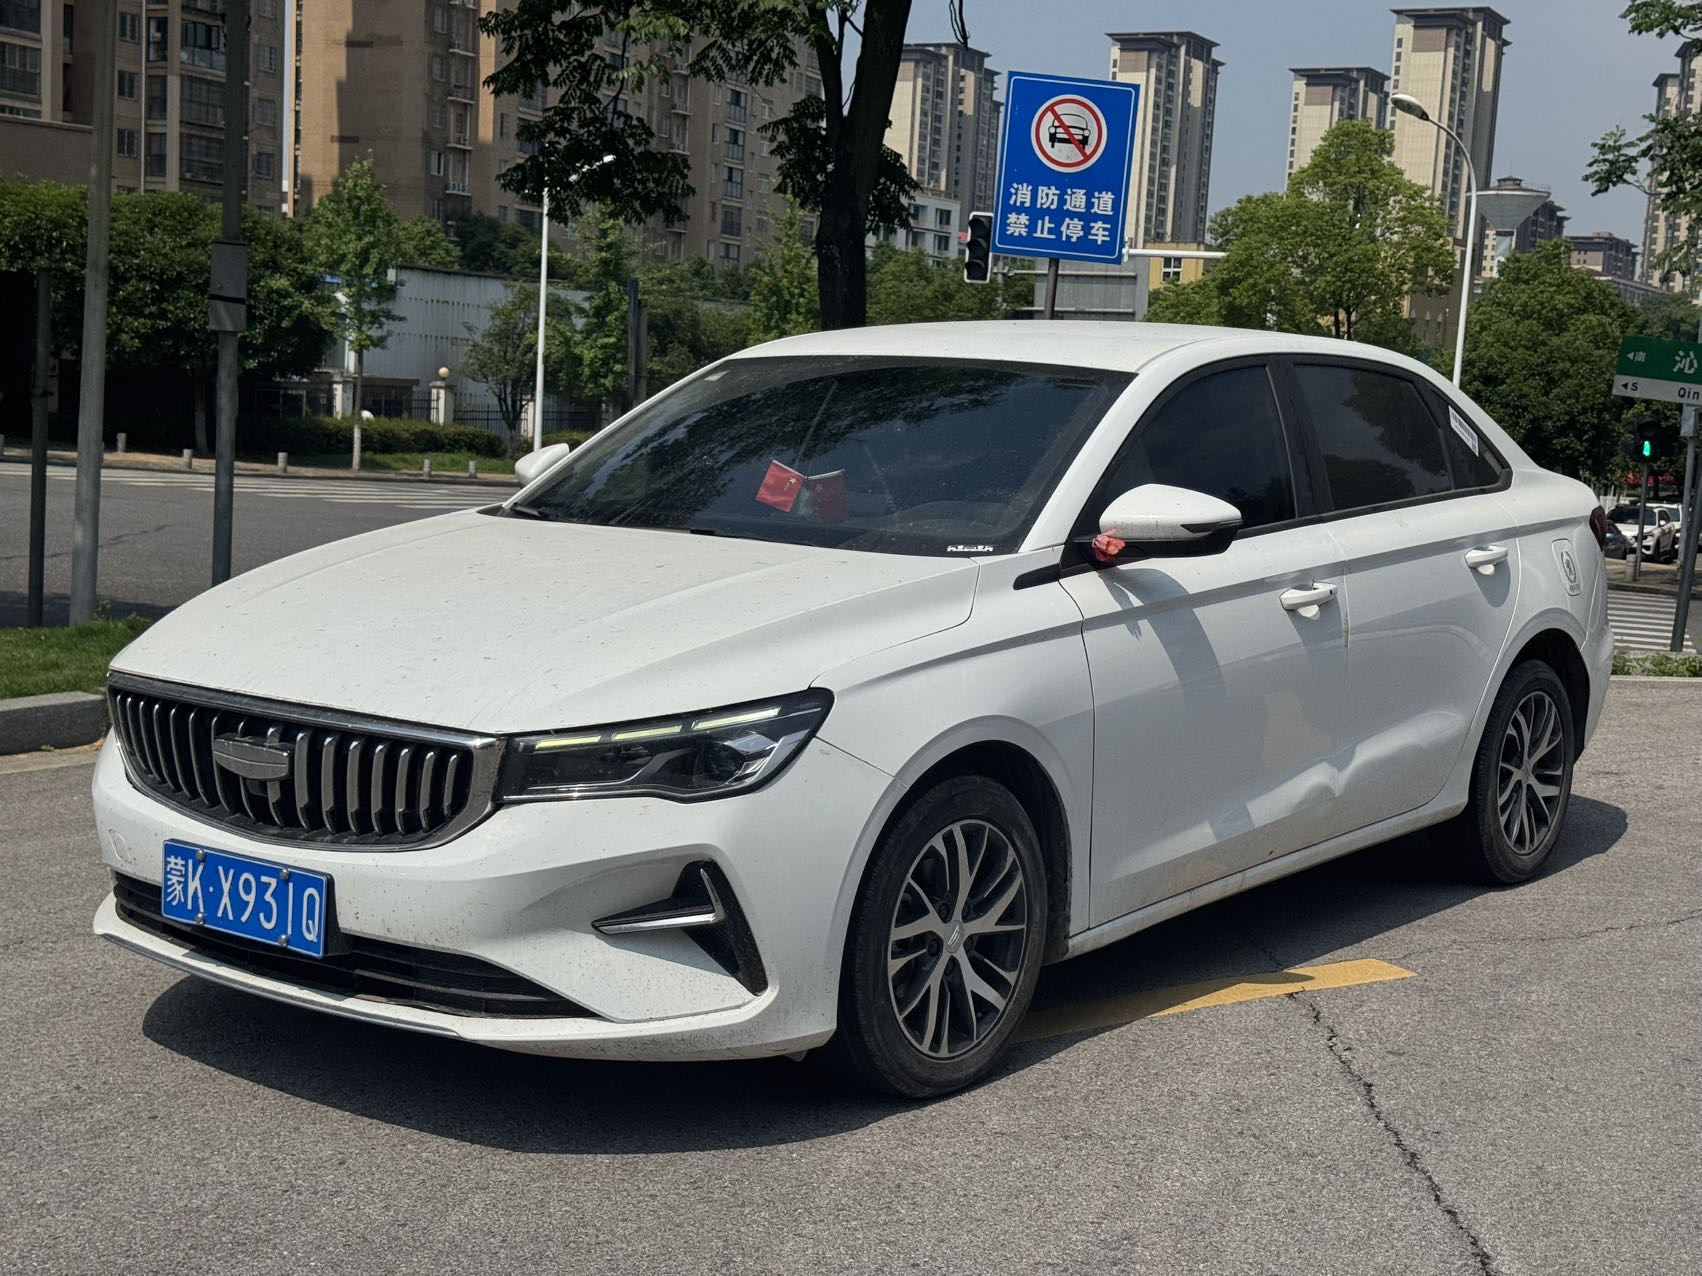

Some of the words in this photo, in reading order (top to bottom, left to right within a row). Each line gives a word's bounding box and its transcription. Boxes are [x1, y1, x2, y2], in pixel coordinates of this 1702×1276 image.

[1008, 182, 1115, 216] 消防通道
[1006, 212, 1112, 245] 禁止停车
[1672, 350, 1698, 375] 沁
[1630, 382, 1639, 392] S
